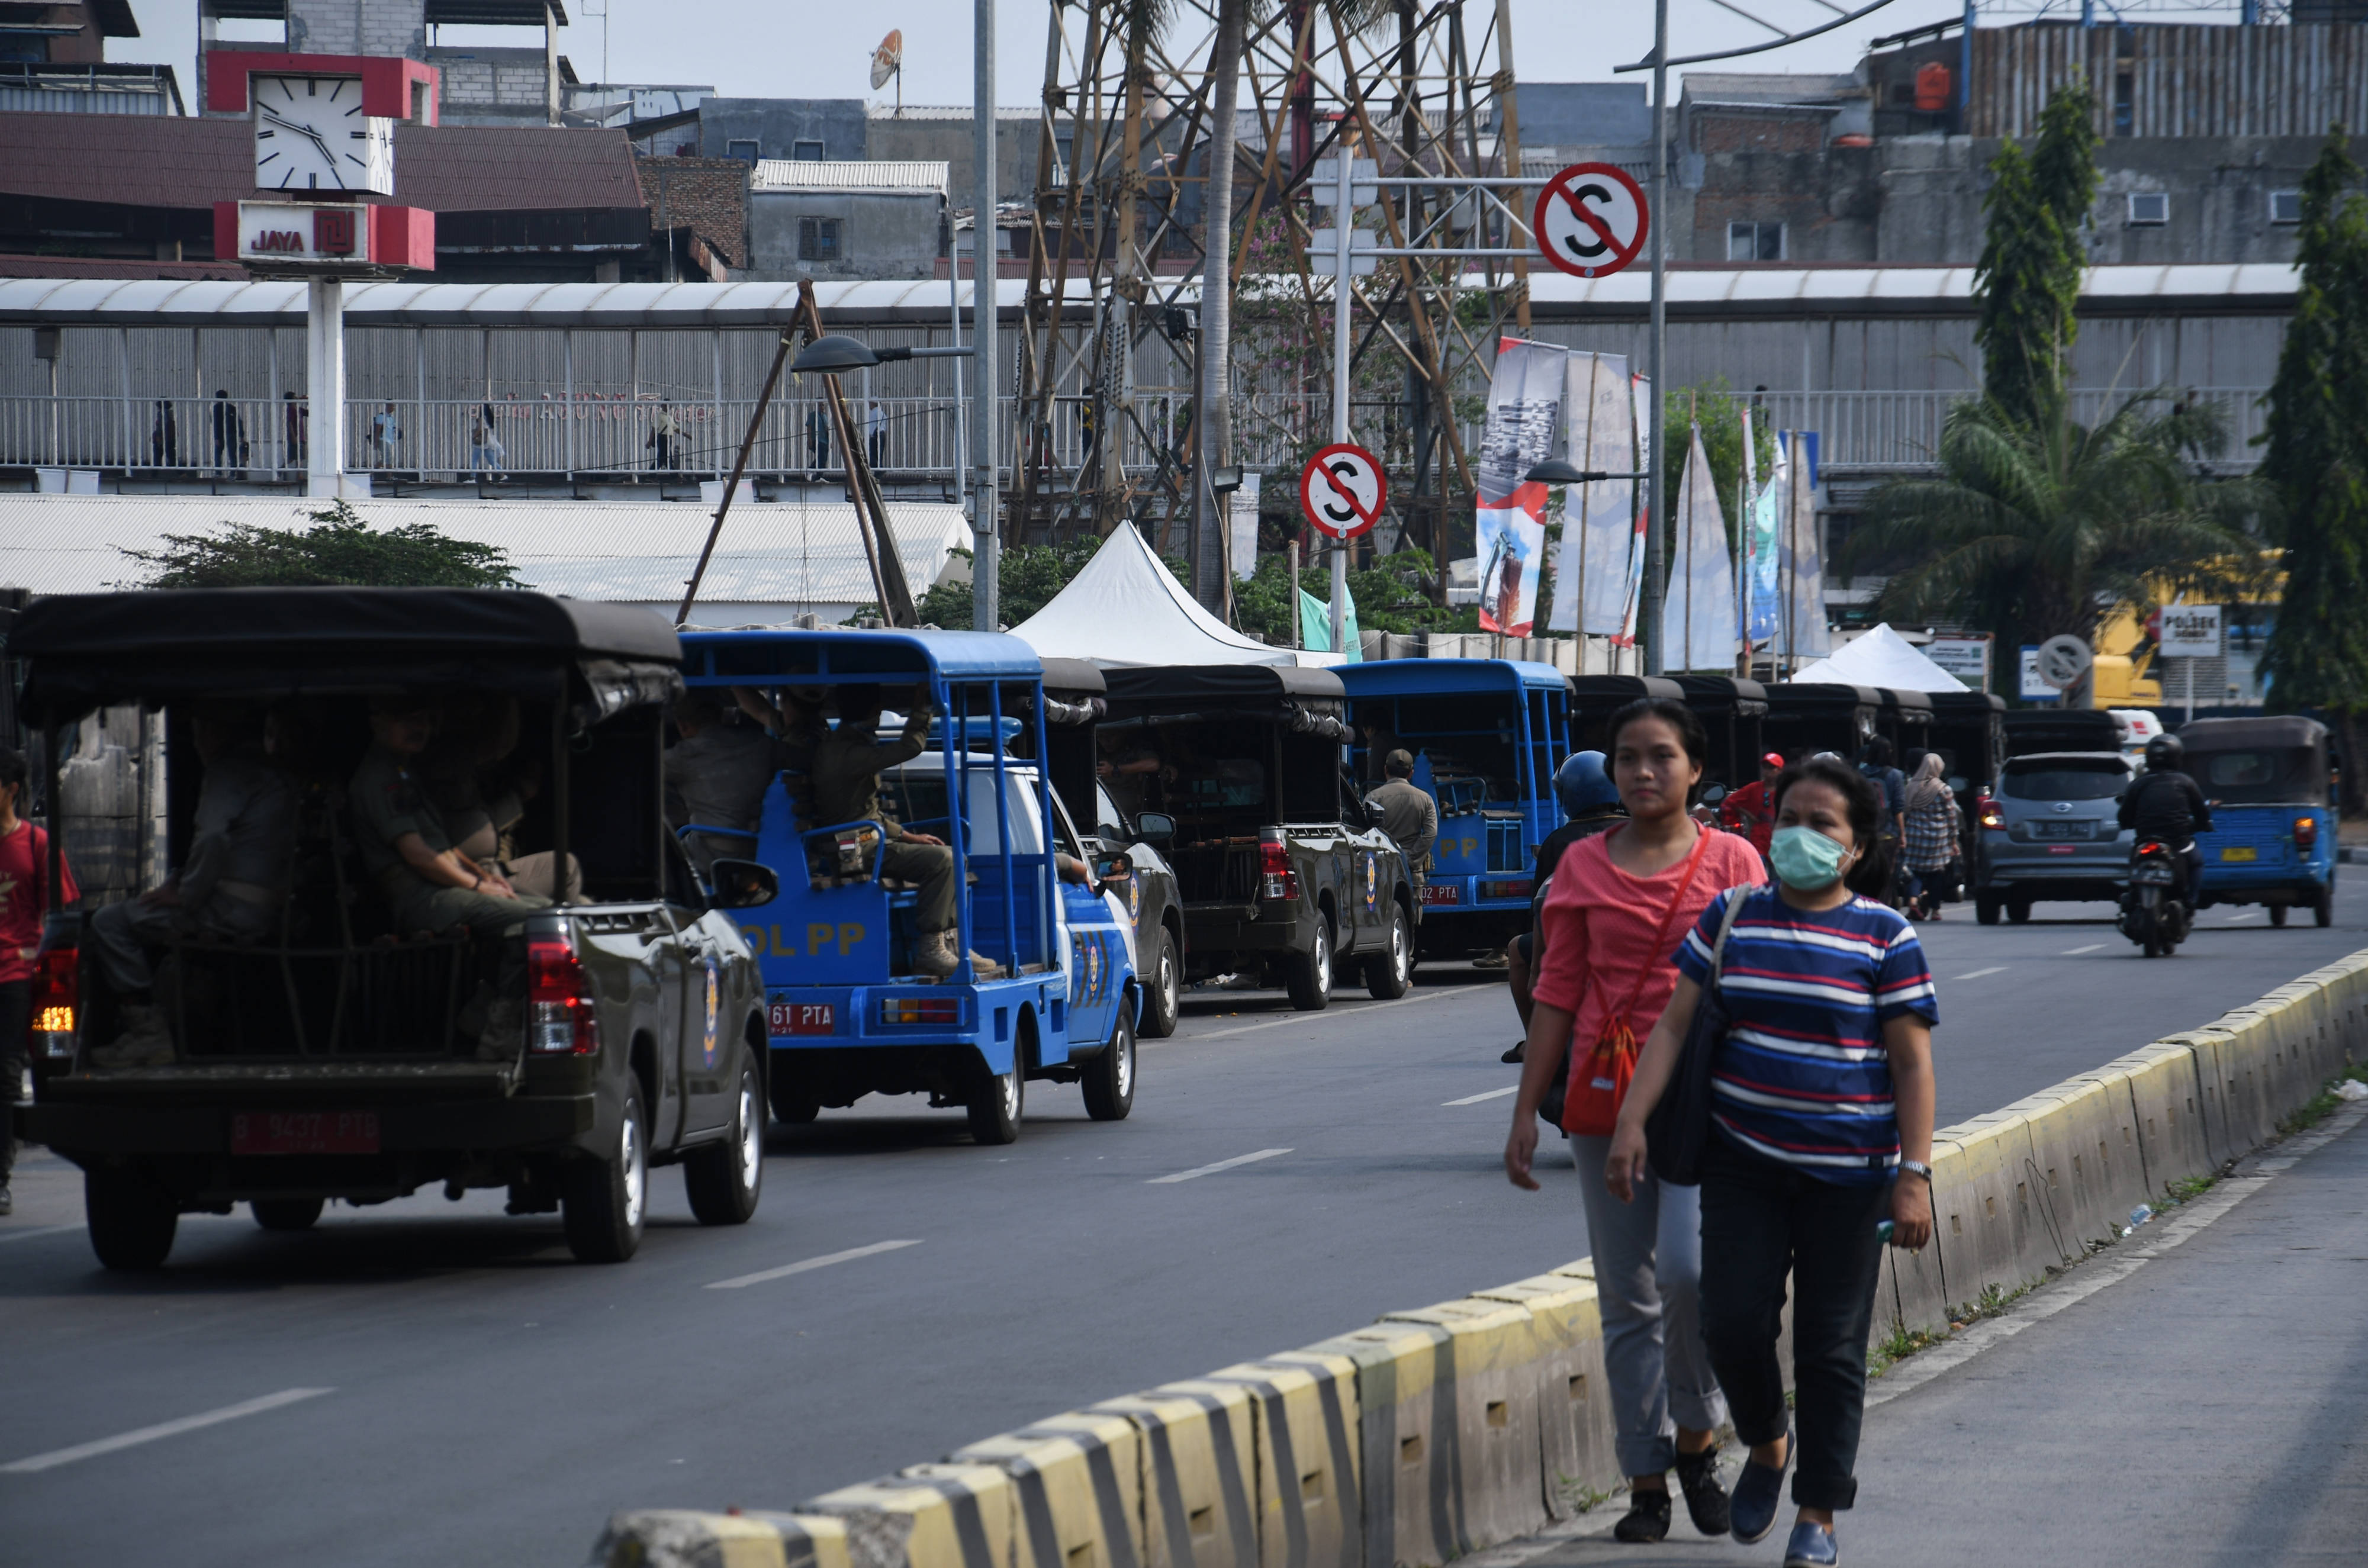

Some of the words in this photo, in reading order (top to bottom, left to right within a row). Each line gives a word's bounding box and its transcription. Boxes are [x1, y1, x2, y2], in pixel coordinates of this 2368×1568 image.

[1565, 184, 1613, 257] S
[251, 230, 304, 252] JAYA
[1324, 461, 1359, 521] S
[1441, 838, 1478, 859] PP
[1421, 887, 1433, 899] 02
[1439, 887, 1456, 899] PTA
[740, 925, 796, 956] OL
[807, 923, 865, 955] PP
[767, 1006, 790, 1025] 61
[803, 1006, 831, 1025] PTA
[236, 1113, 249, 1139] B
[270, 1113, 322, 1139] 9437
[337, 1113, 377, 1139] PTB
